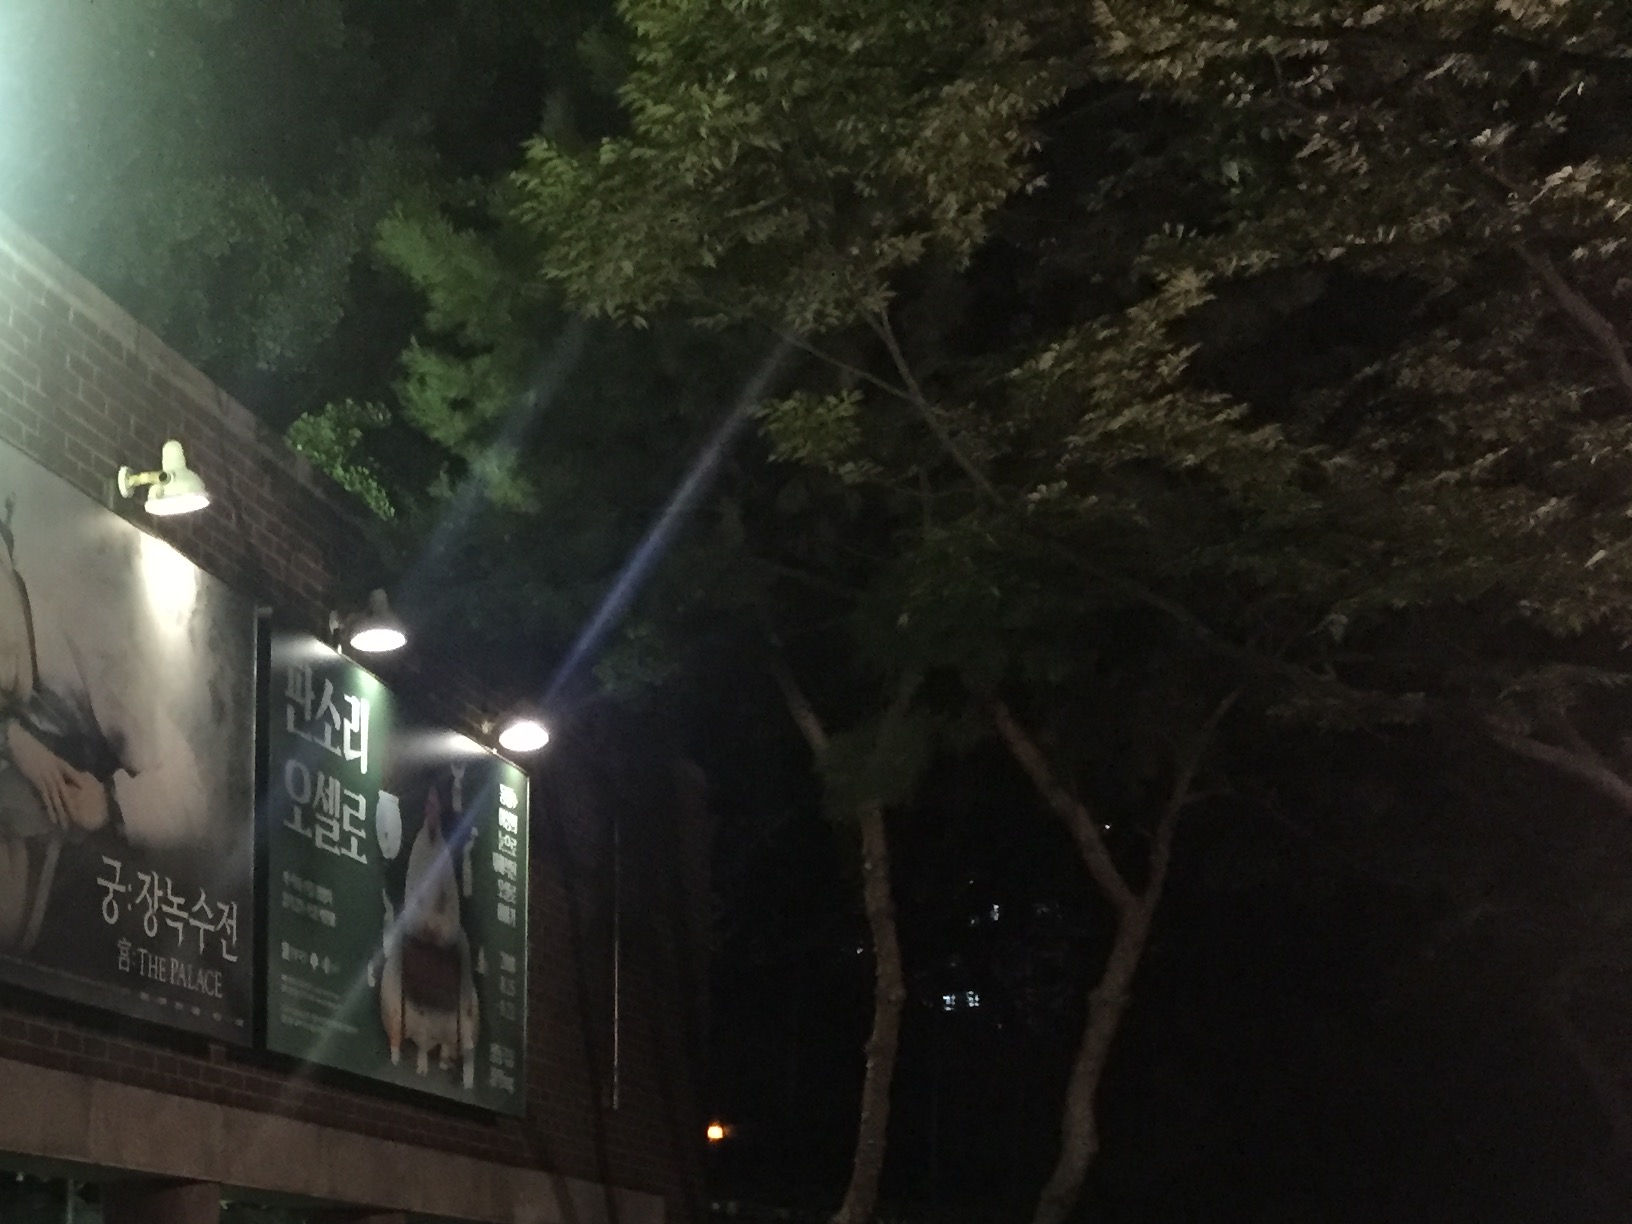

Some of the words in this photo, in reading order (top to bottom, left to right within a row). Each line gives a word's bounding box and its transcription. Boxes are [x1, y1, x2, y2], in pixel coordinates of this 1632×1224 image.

[284, 661, 369, 775] 판소리
[282, 757, 369, 866] 오셀로
[169, 957, 224, 999] PALACE
